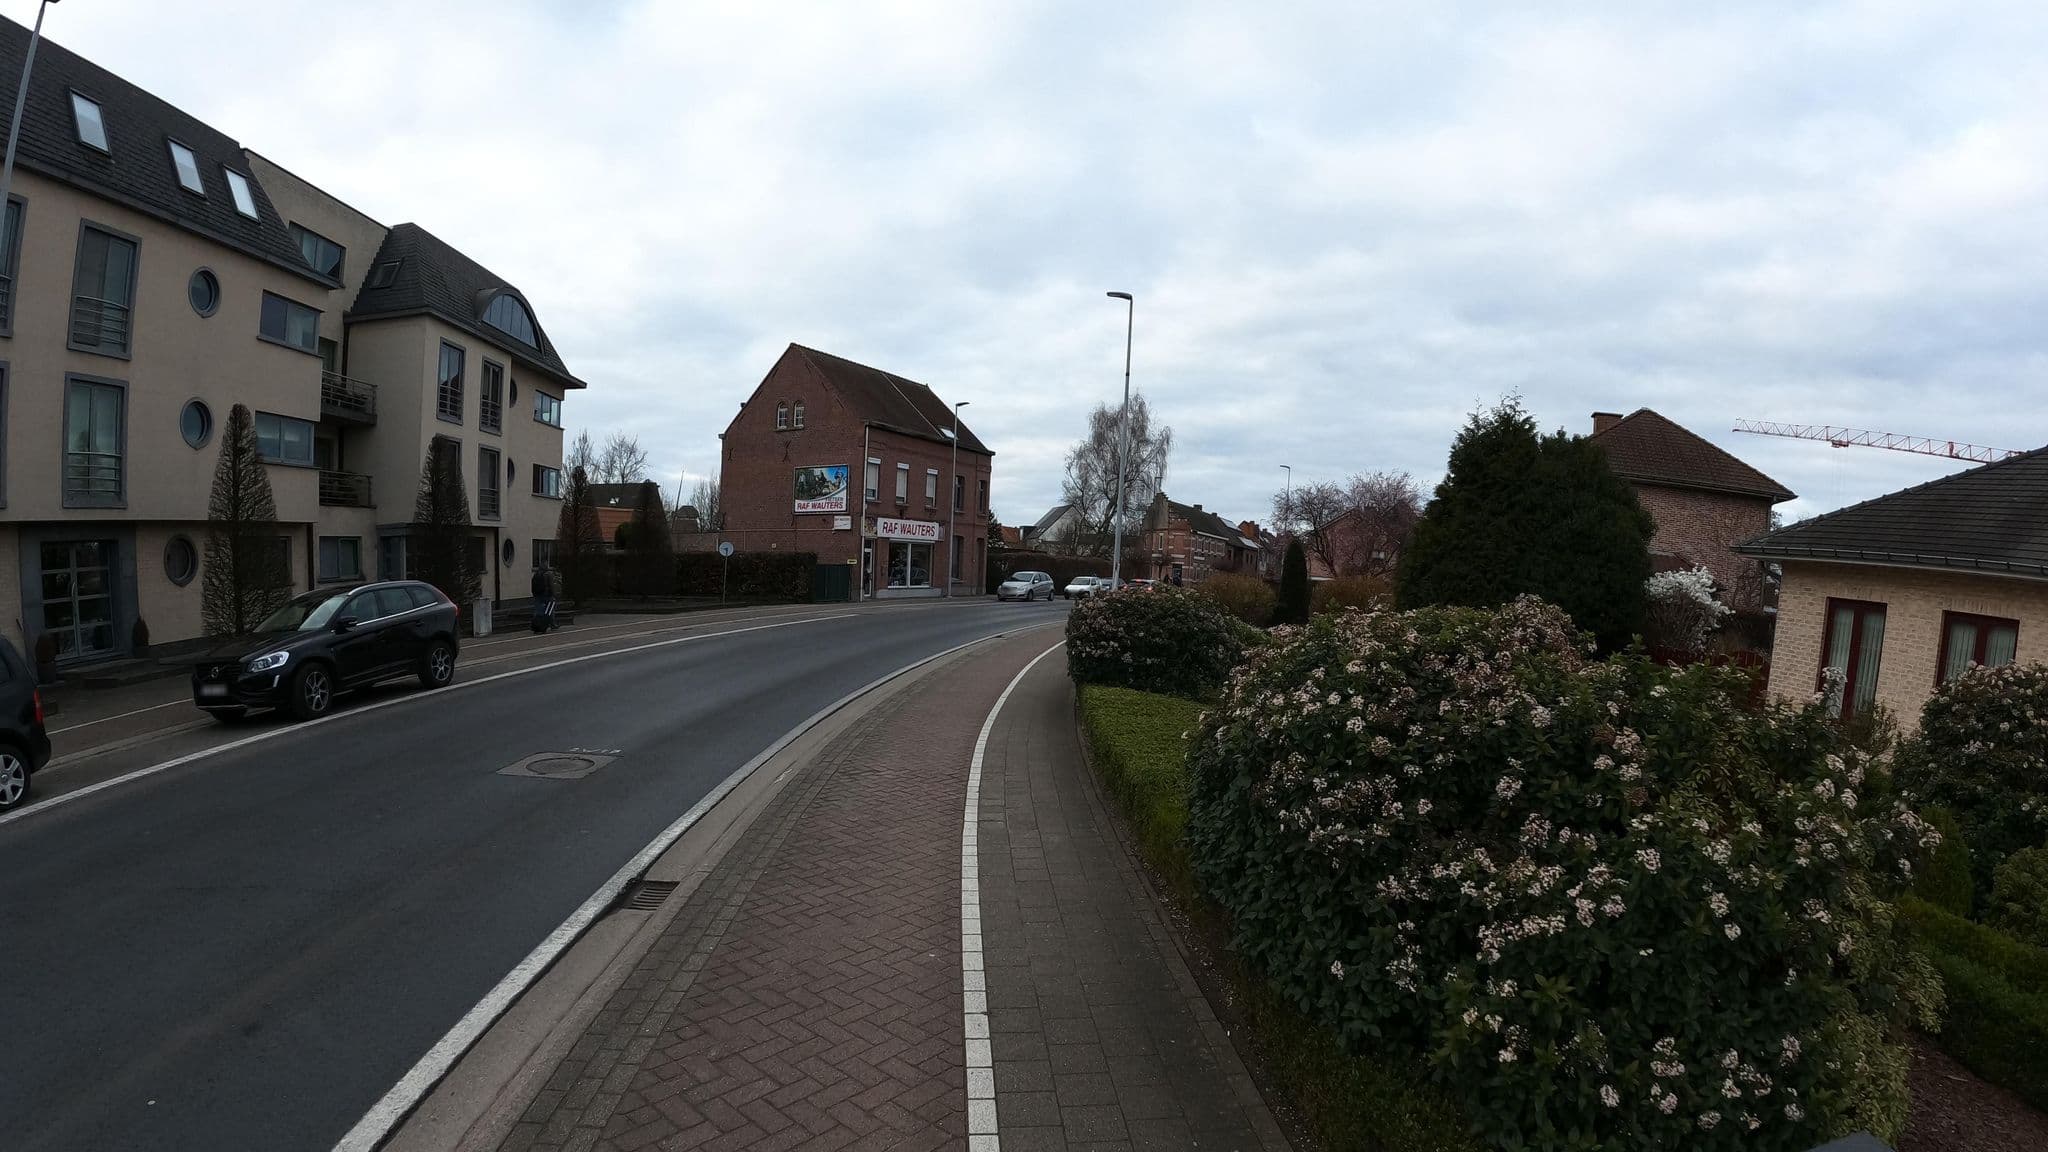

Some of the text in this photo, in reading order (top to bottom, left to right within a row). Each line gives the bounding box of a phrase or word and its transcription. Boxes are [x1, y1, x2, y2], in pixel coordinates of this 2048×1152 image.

[811, 501, 843, 509] WAUTERS
[882, 521, 936, 537] RAF WAUTERS
